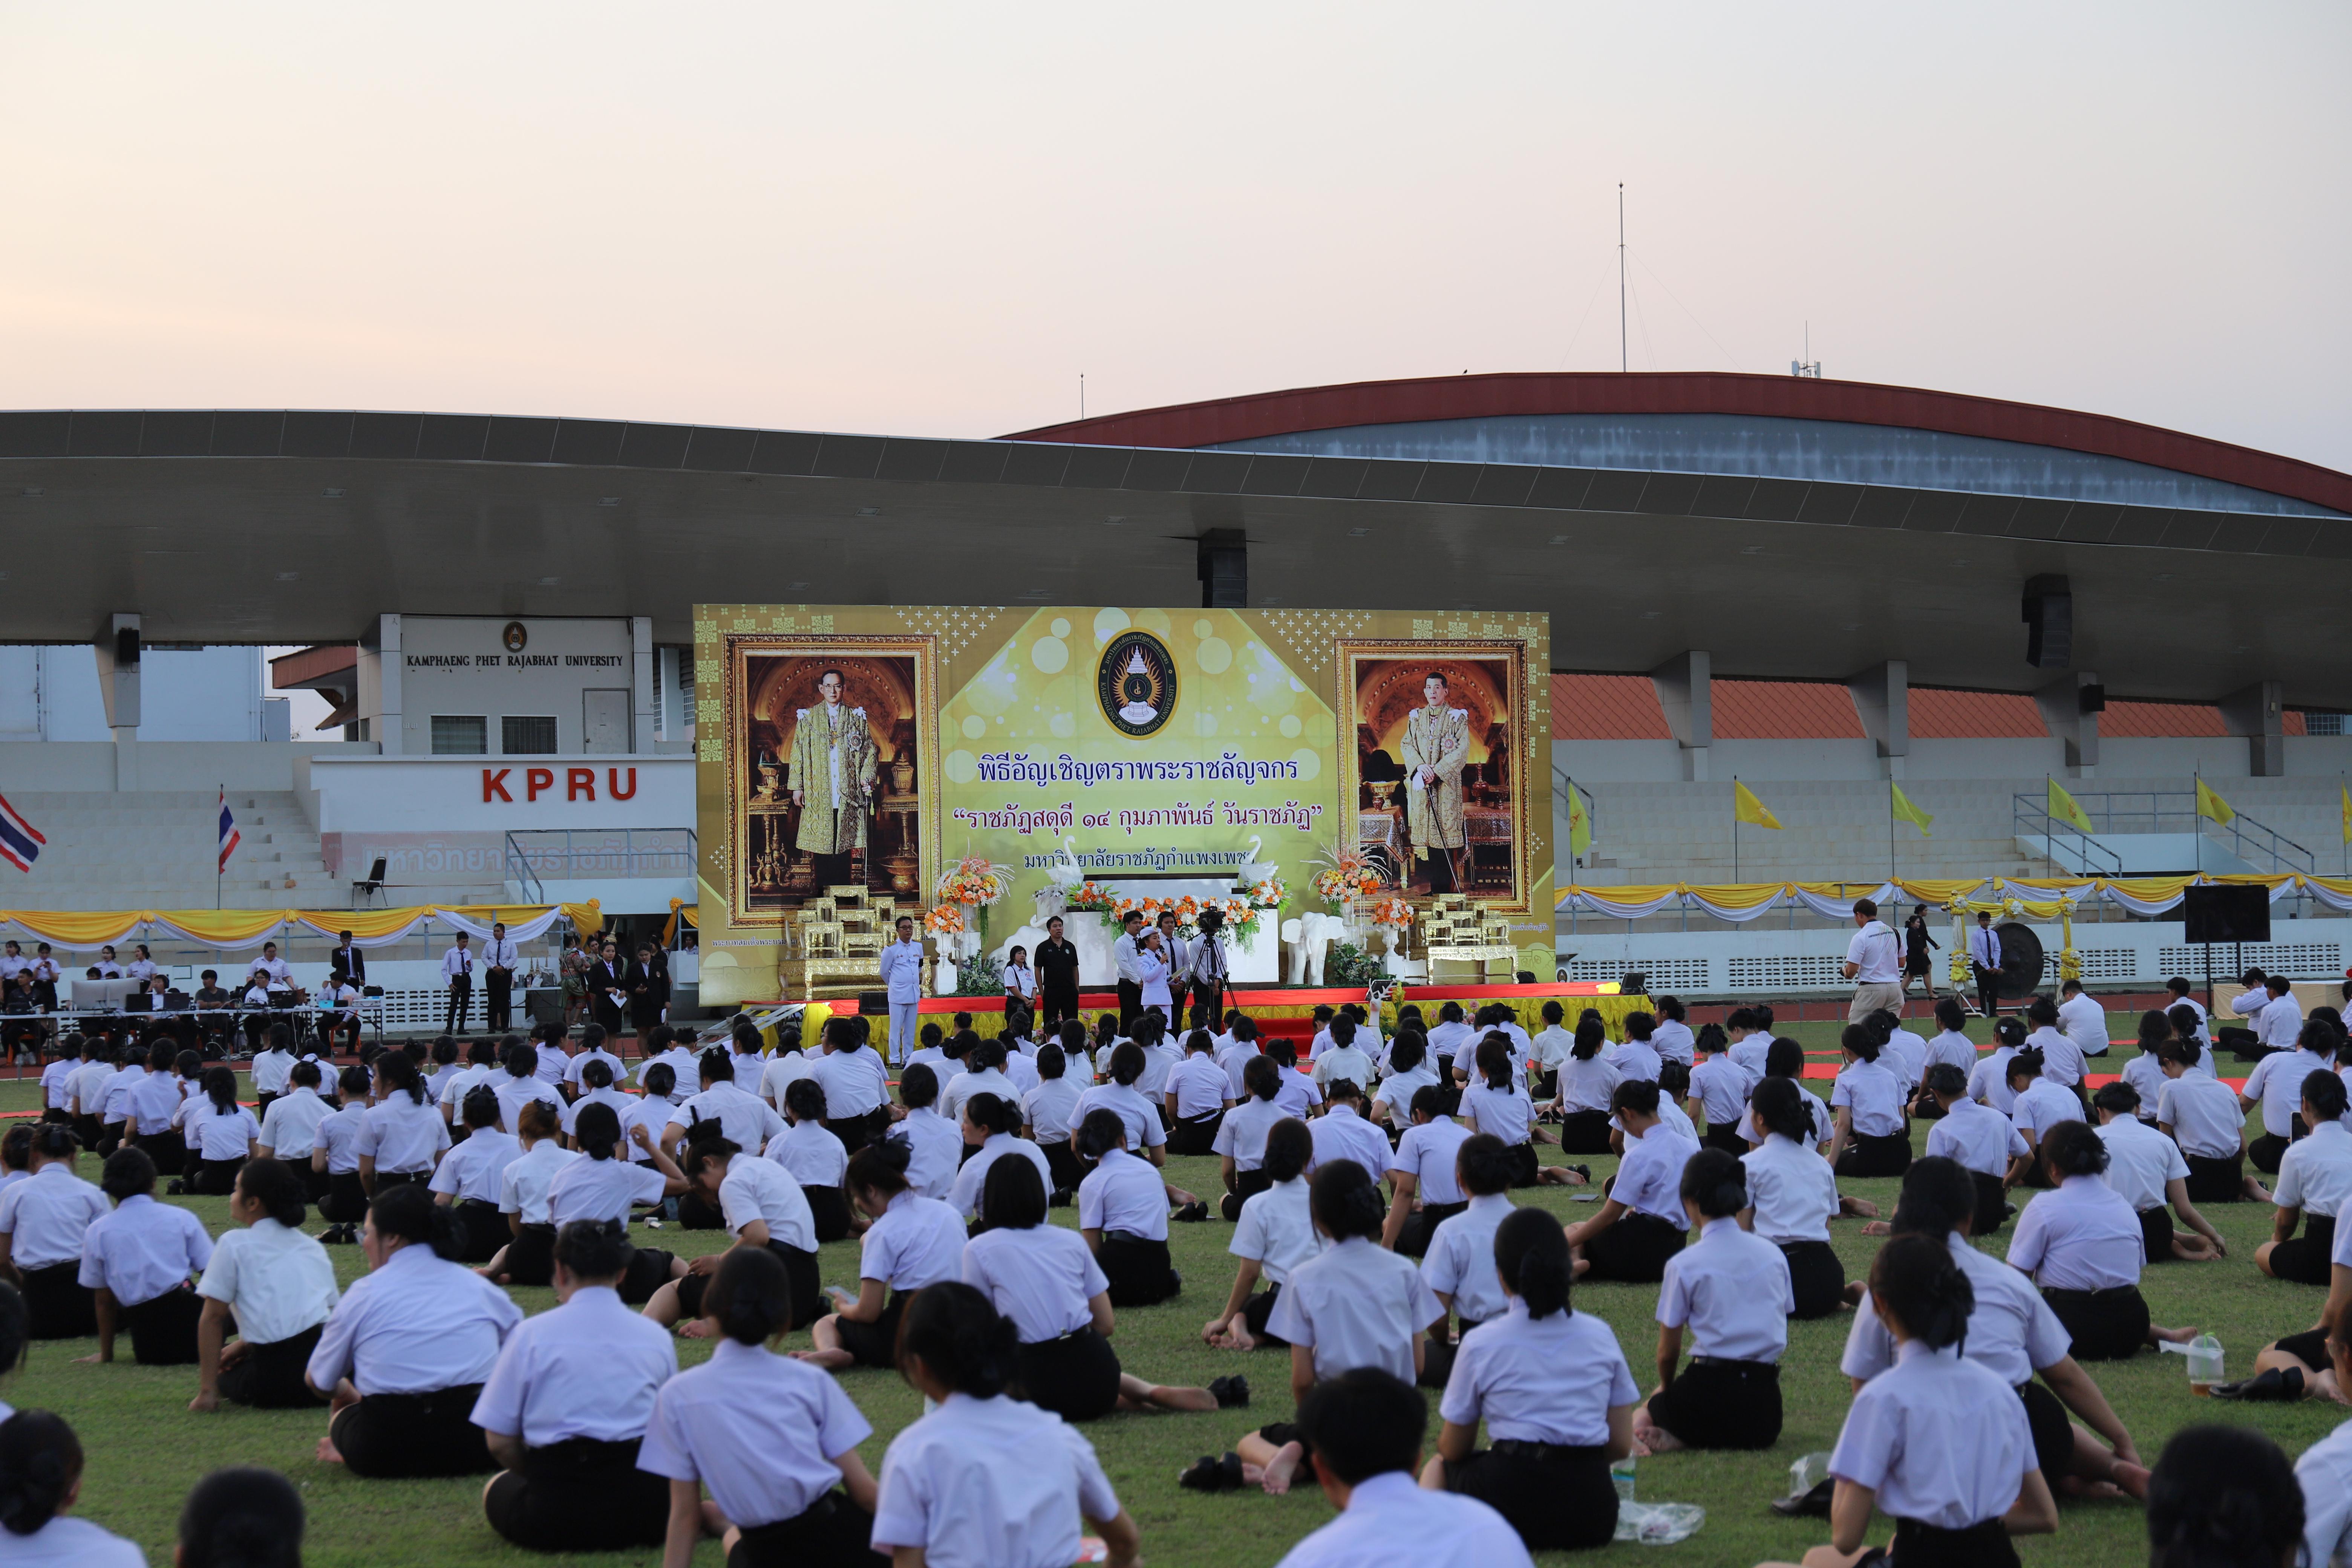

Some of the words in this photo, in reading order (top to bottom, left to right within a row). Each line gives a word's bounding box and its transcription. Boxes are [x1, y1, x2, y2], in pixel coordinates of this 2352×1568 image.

[407, 655, 470, 666] KAMPHAENG
[475, 655, 501, 666] PHET
[507, 655, 559, 669] RAJABHAT
[565, 655, 623, 666] UNIVERSITY
[1101, 682, 1118, 721] KAMPHAENG
[1116, 720, 1131, 732] PHET
[1132, 718, 1162, 735] RAJABHAT
[1160, 684, 1175, 720] UNIVERSITY
[482, 767, 636, 802] KPRU
[978, 752, 1297, 787] พิธีอัญเชิญตราพระราชลัญจกร
[1083, 810, 1110, 828] ๑๔
[1119, 800, 1215, 835] กุมภาพันธ์
[1222, 801, 1322, 830] วันราชภัฏ”
[363, 834, 697, 878] มหาวิทยาลัยราชภัฏกำแ
